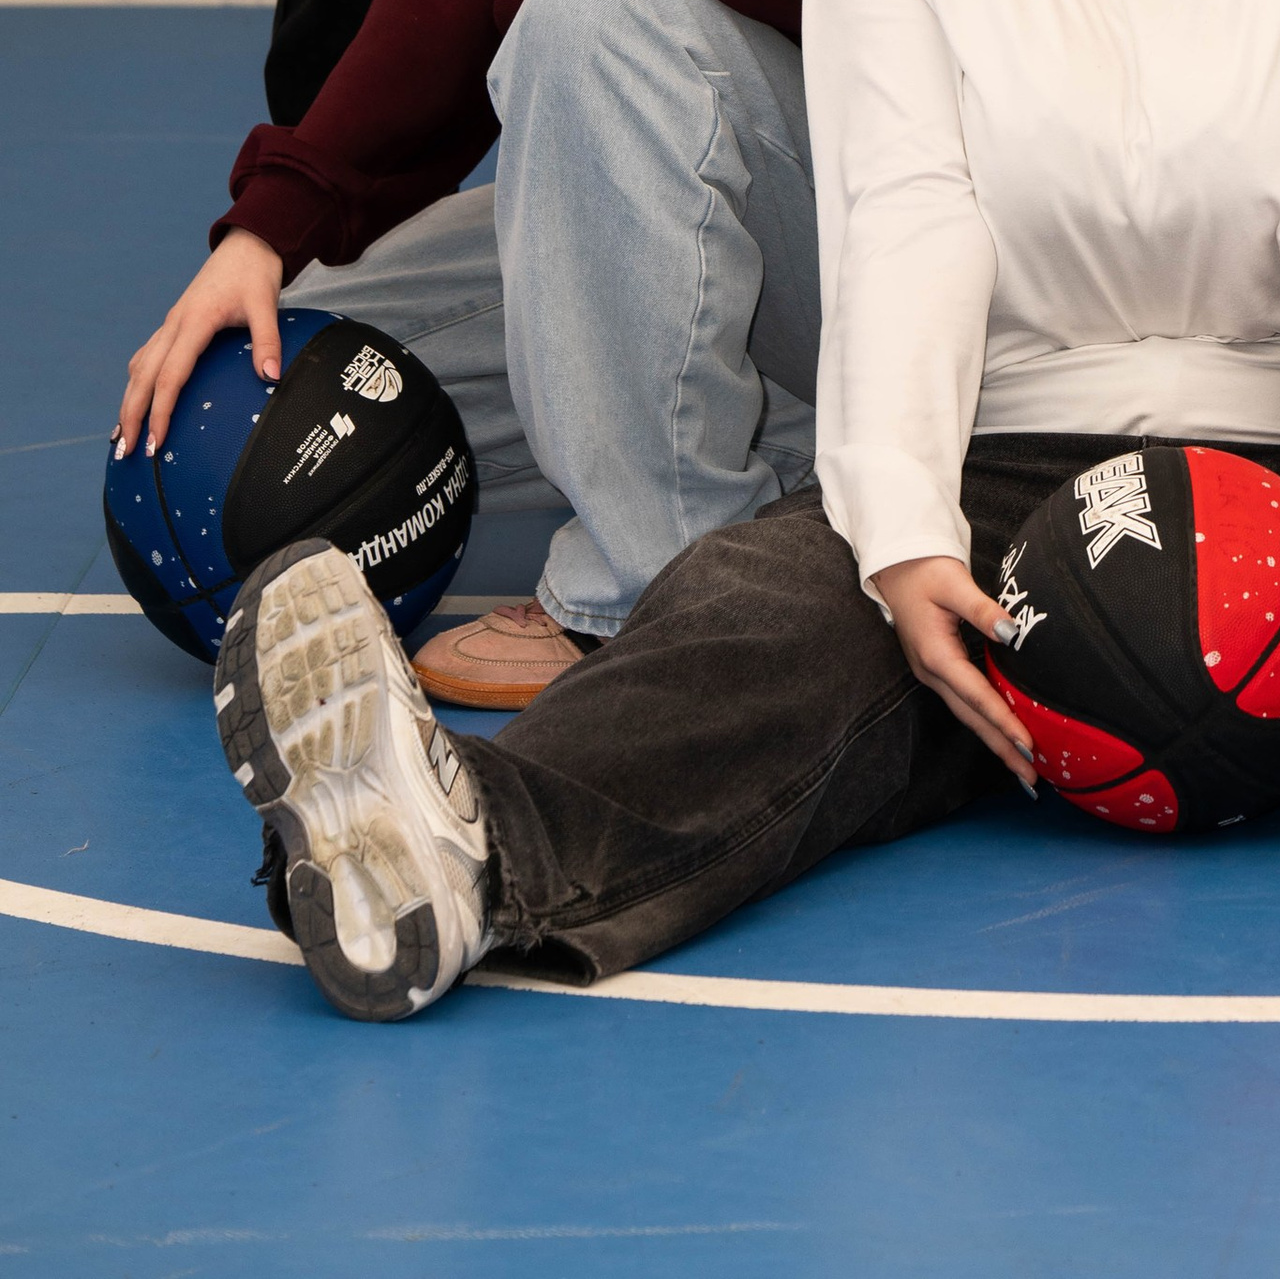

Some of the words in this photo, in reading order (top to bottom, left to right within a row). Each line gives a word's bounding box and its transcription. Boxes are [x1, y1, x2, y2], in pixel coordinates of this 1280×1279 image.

[283, 429, 329, 485] ПРЕЗИДЕНТСКИХ
[296, 424, 321, 454] ГРАНТОВ
[313, 435, 334, 459] ФОНДА
[415, 446, 456, 496] KES-BASKET.RU
[347, 493, 445, 572] КОМАНДА
[1074, 451, 1162, 570] EAK
